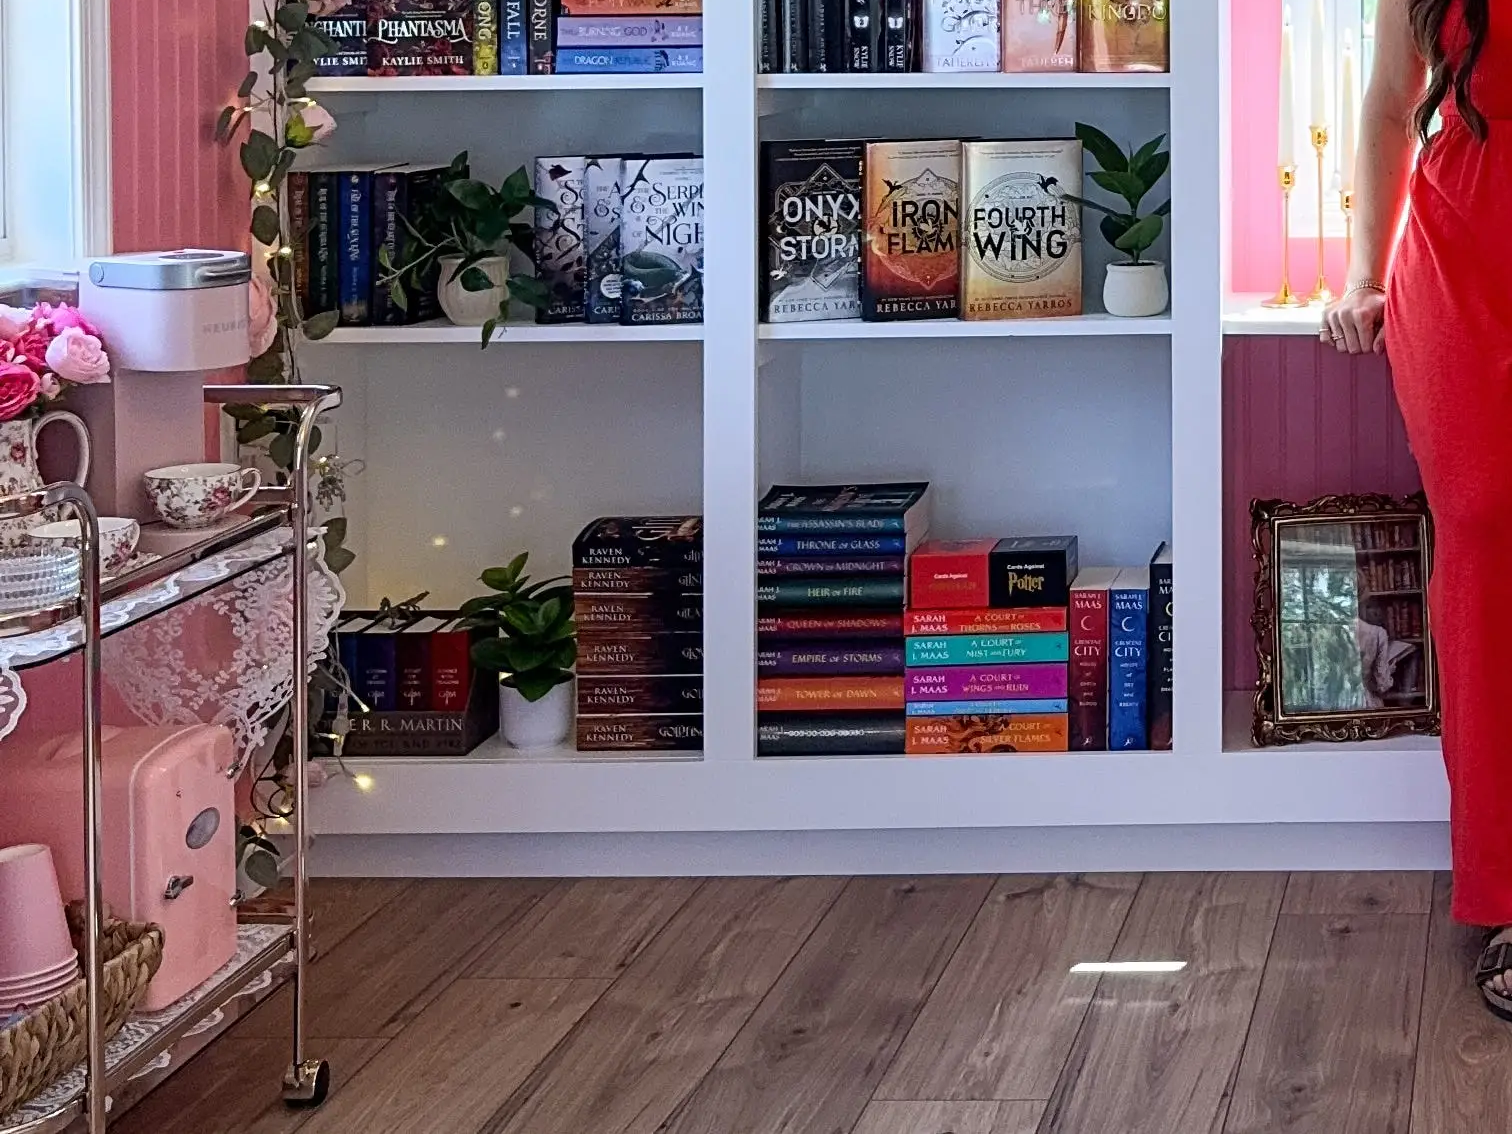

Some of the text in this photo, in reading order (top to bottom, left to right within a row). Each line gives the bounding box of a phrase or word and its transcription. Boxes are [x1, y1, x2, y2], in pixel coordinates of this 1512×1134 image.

[366, 17, 473, 45] PHANTASMA
[382, 55, 464, 66] KAYLIE SMITH
[574, 54, 613, 65] DRAGON
[853, 46, 861, 69] SNOW
[860, 45, 869, 69] KYLIE
[895, 44, 904, 68] KYLIE
[783, 193, 860, 223] ONYX
[892, 197, 960, 228] IRON
[973, 204, 1067, 230] FOURTH
[972, 228, 1069, 261] WING
[968, 303, 1024, 314] REBECCA
[1027, 299, 1074, 311] YARROS
[631, 312, 672, 324] CARISSA
[590, 547, 623, 556] RAVEN
[1023, 563, 1045, 571] Against
[588, 571, 622, 580] RAVEN
[1007, 570, 1045, 597] Potter
[583, 612, 632, 623] KENNEDY
[913, 614, 947, 624] SARAH
[913, 640, 947, 650] SARAH
[586, 651, 635, 663] KENNEDY
[1073, 646, 1102, 658] CITY
[1114, 646, 1143, 659] CITY
[913, 674, 946, 684] SARAH
[587, 694, 636, 705] KENNEDY
[914, 724, 948, 734] SARAH
[586, 732, 634, 743] KENNEDY
